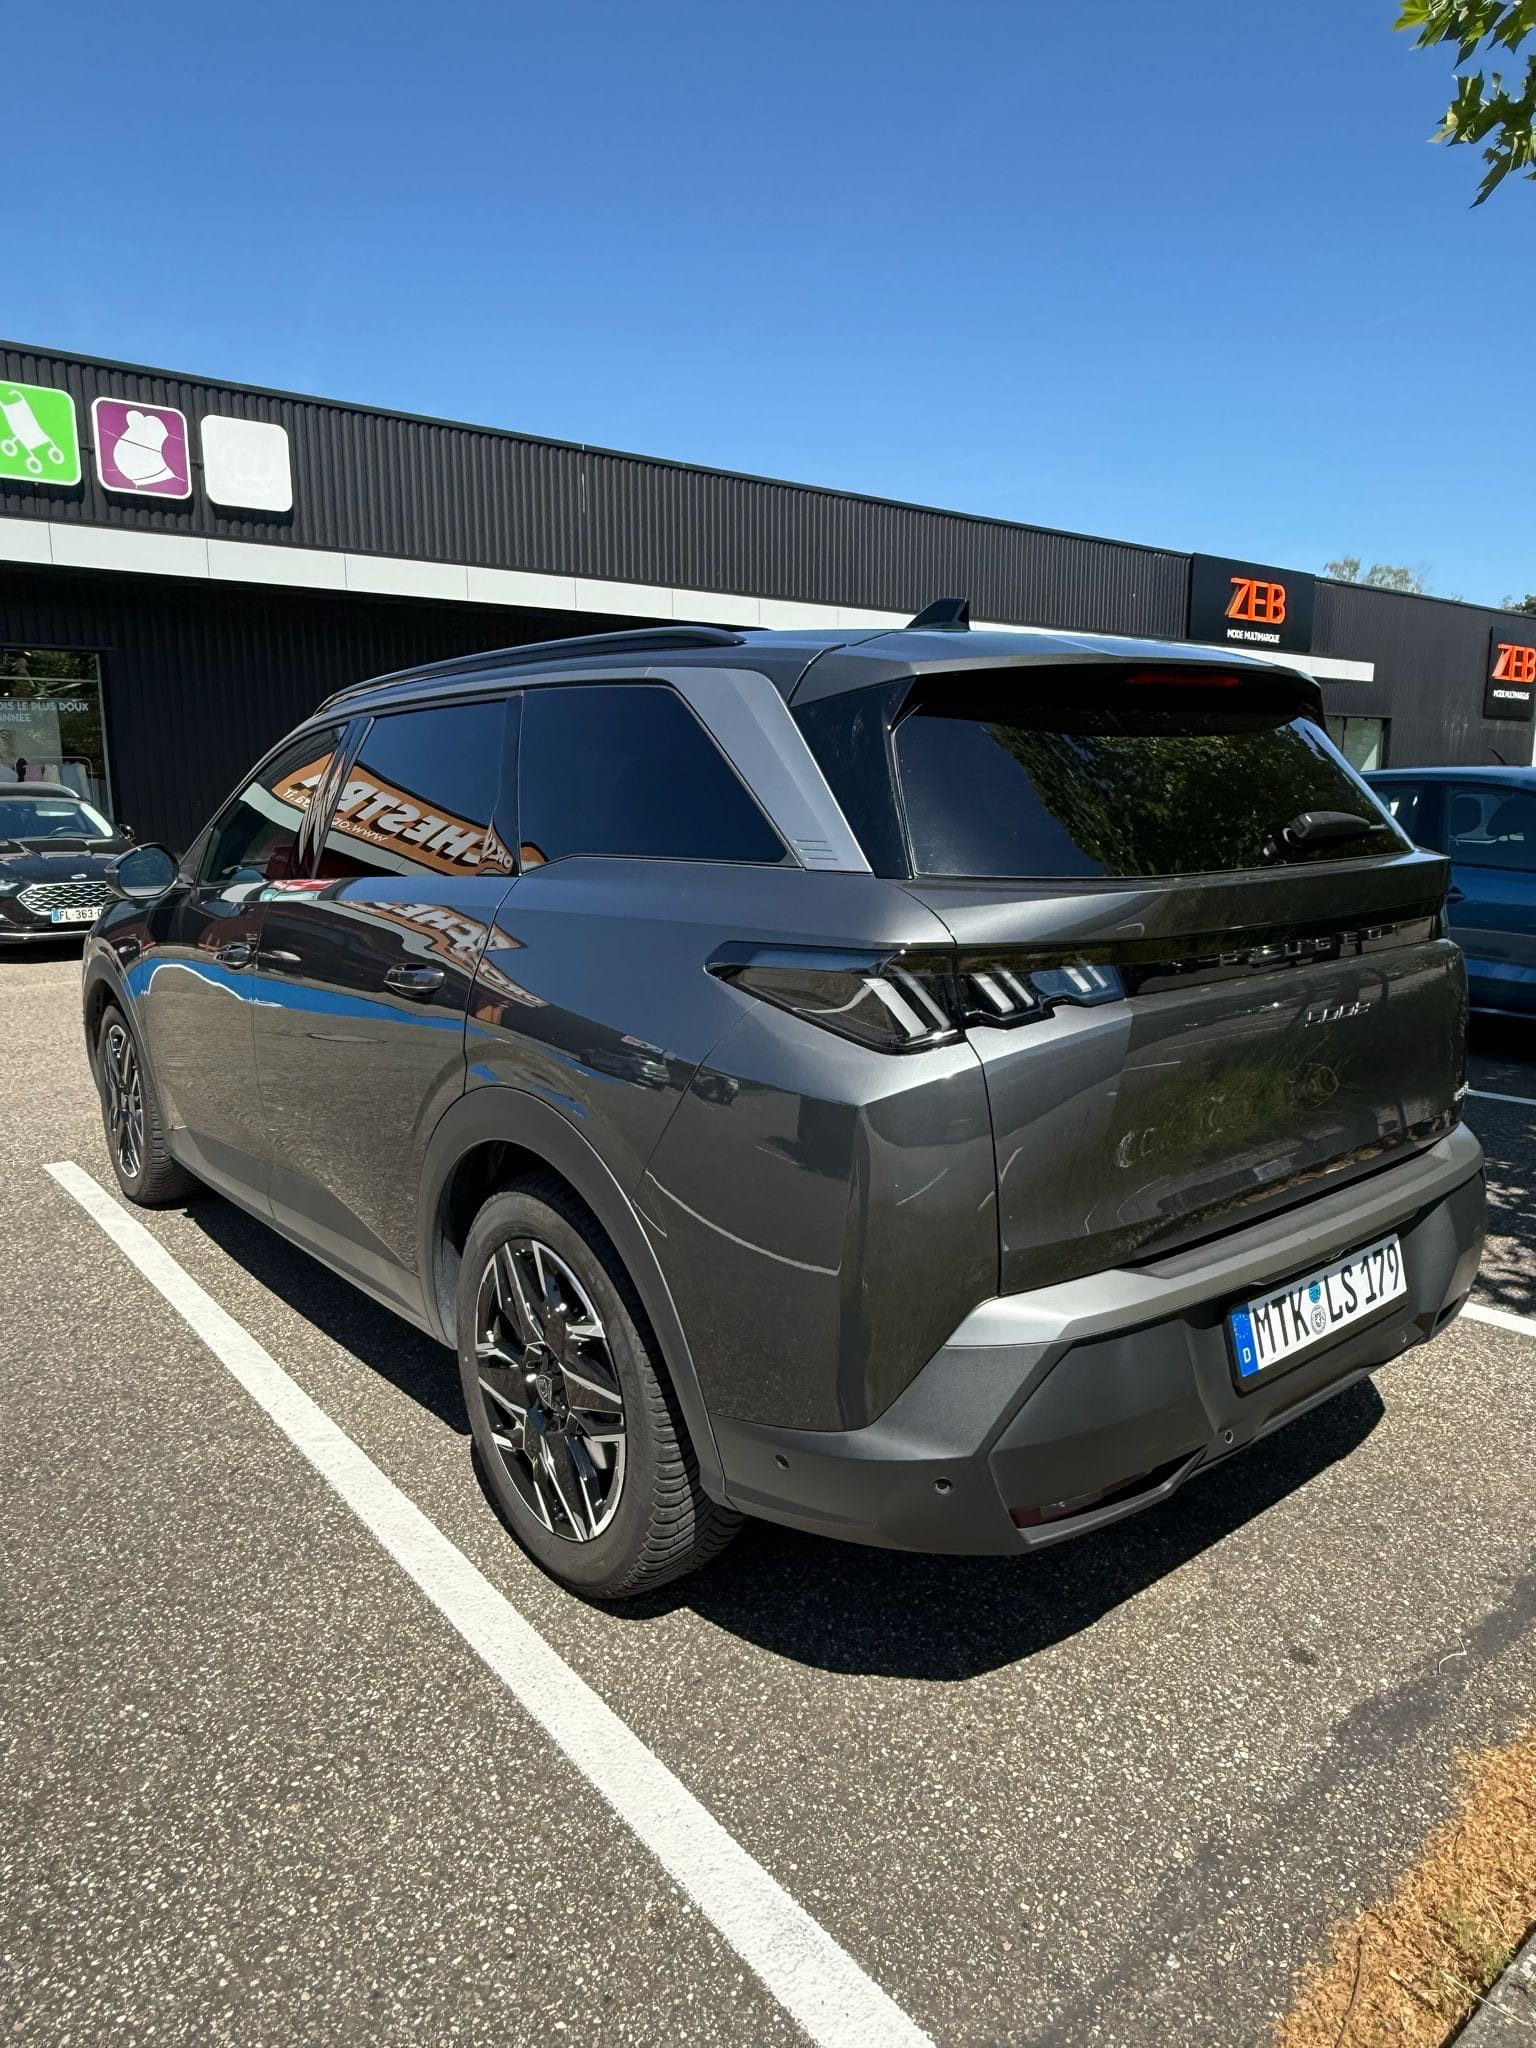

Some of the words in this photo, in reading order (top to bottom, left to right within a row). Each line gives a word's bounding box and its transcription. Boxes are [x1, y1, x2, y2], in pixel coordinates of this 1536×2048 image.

[1226, 577, 1285, 624] ZEB
[1492, 643, 1536, 682] ZEB
[17, 702, 28, 711] LE
[31, 702, 57, 711] PLUS
[59, 702, 88, 711] DOUX
[1252, 1286, 1310, 1359] MTK
[1323, 1264, 1358, 1323] LS
[1360, 1243, 1399, 1305] 179
[1243, 1347, 1251, 1363] D
